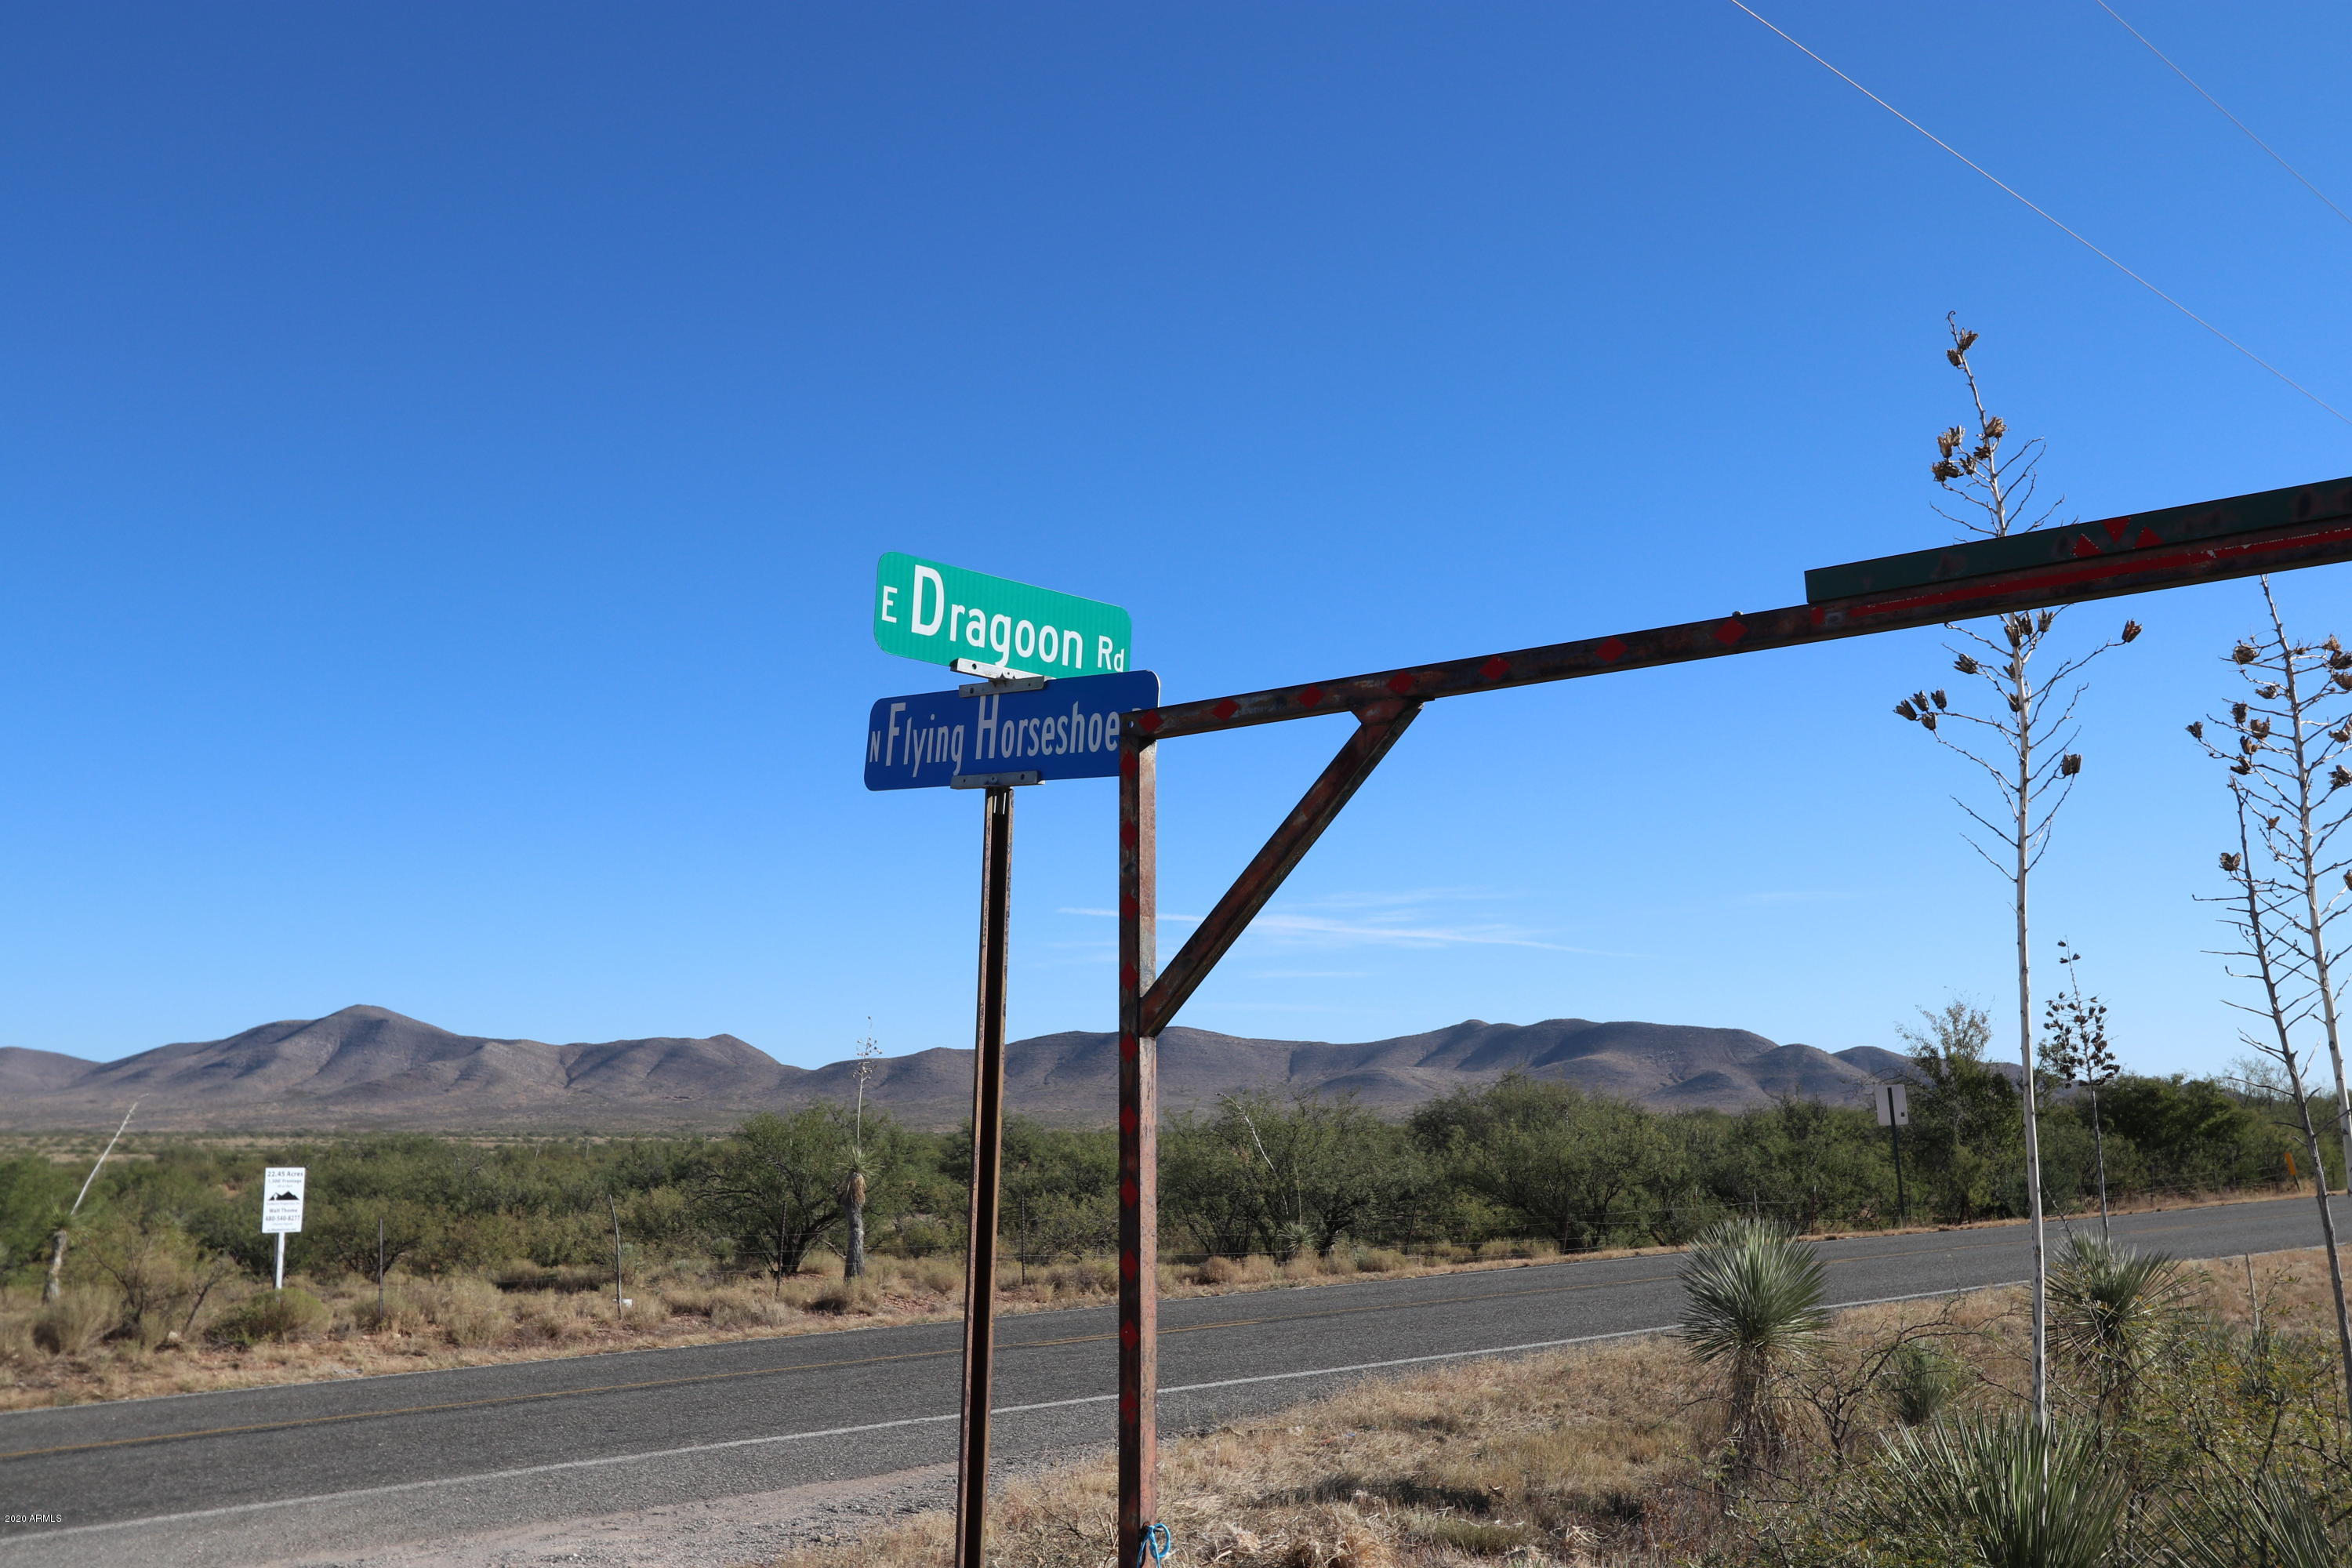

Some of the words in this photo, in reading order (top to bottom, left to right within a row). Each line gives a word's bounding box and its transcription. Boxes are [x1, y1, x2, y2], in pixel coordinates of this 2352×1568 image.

[881, 586, 898, 623] E
[911, 564, 1083, 669] Dragoon
[1098, 635, 1125, 673] Rd
[869, 731, 880, 763] N
[885, 702, 964, 778] Flying
[975, 694, 1120, 760] Horseshoe
